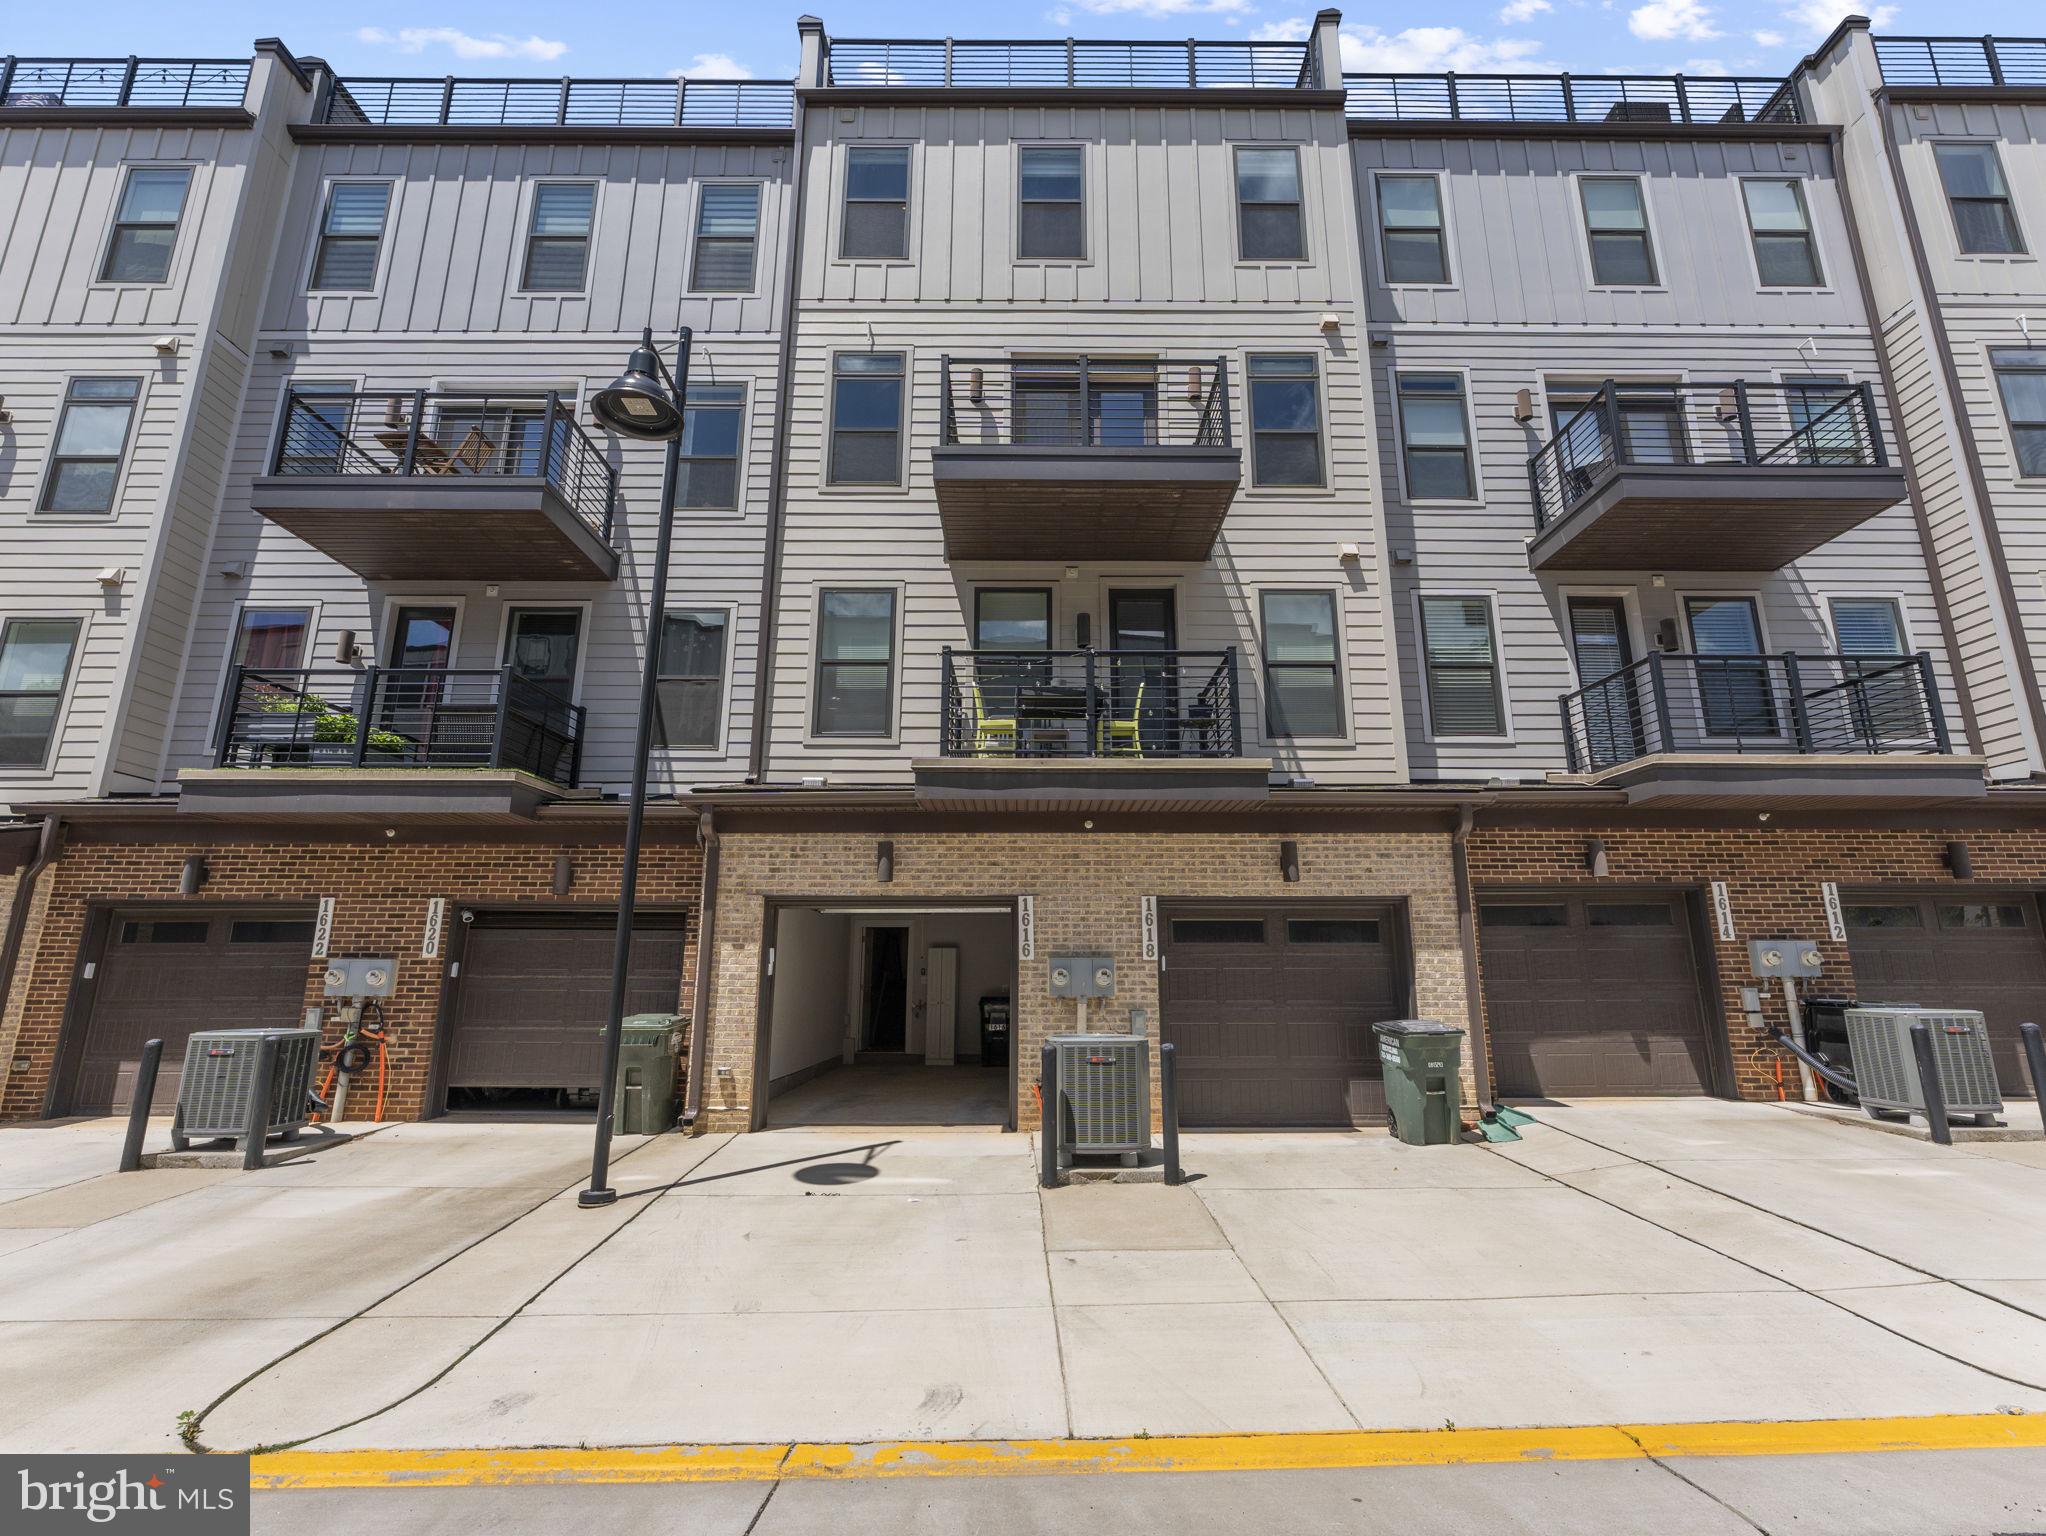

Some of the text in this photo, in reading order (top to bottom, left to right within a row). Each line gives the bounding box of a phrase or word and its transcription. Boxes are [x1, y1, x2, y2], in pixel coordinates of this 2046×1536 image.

[315, 899, 329, 956] 1622
[426, 901, 439, 955] 1620
[1021, 898, 1031, 958] 1616
[1145, 898, 1155, 958] 1618
[1716, 883, 1731, 939] 1614
[1827, 883, 1843, 939] 1612
